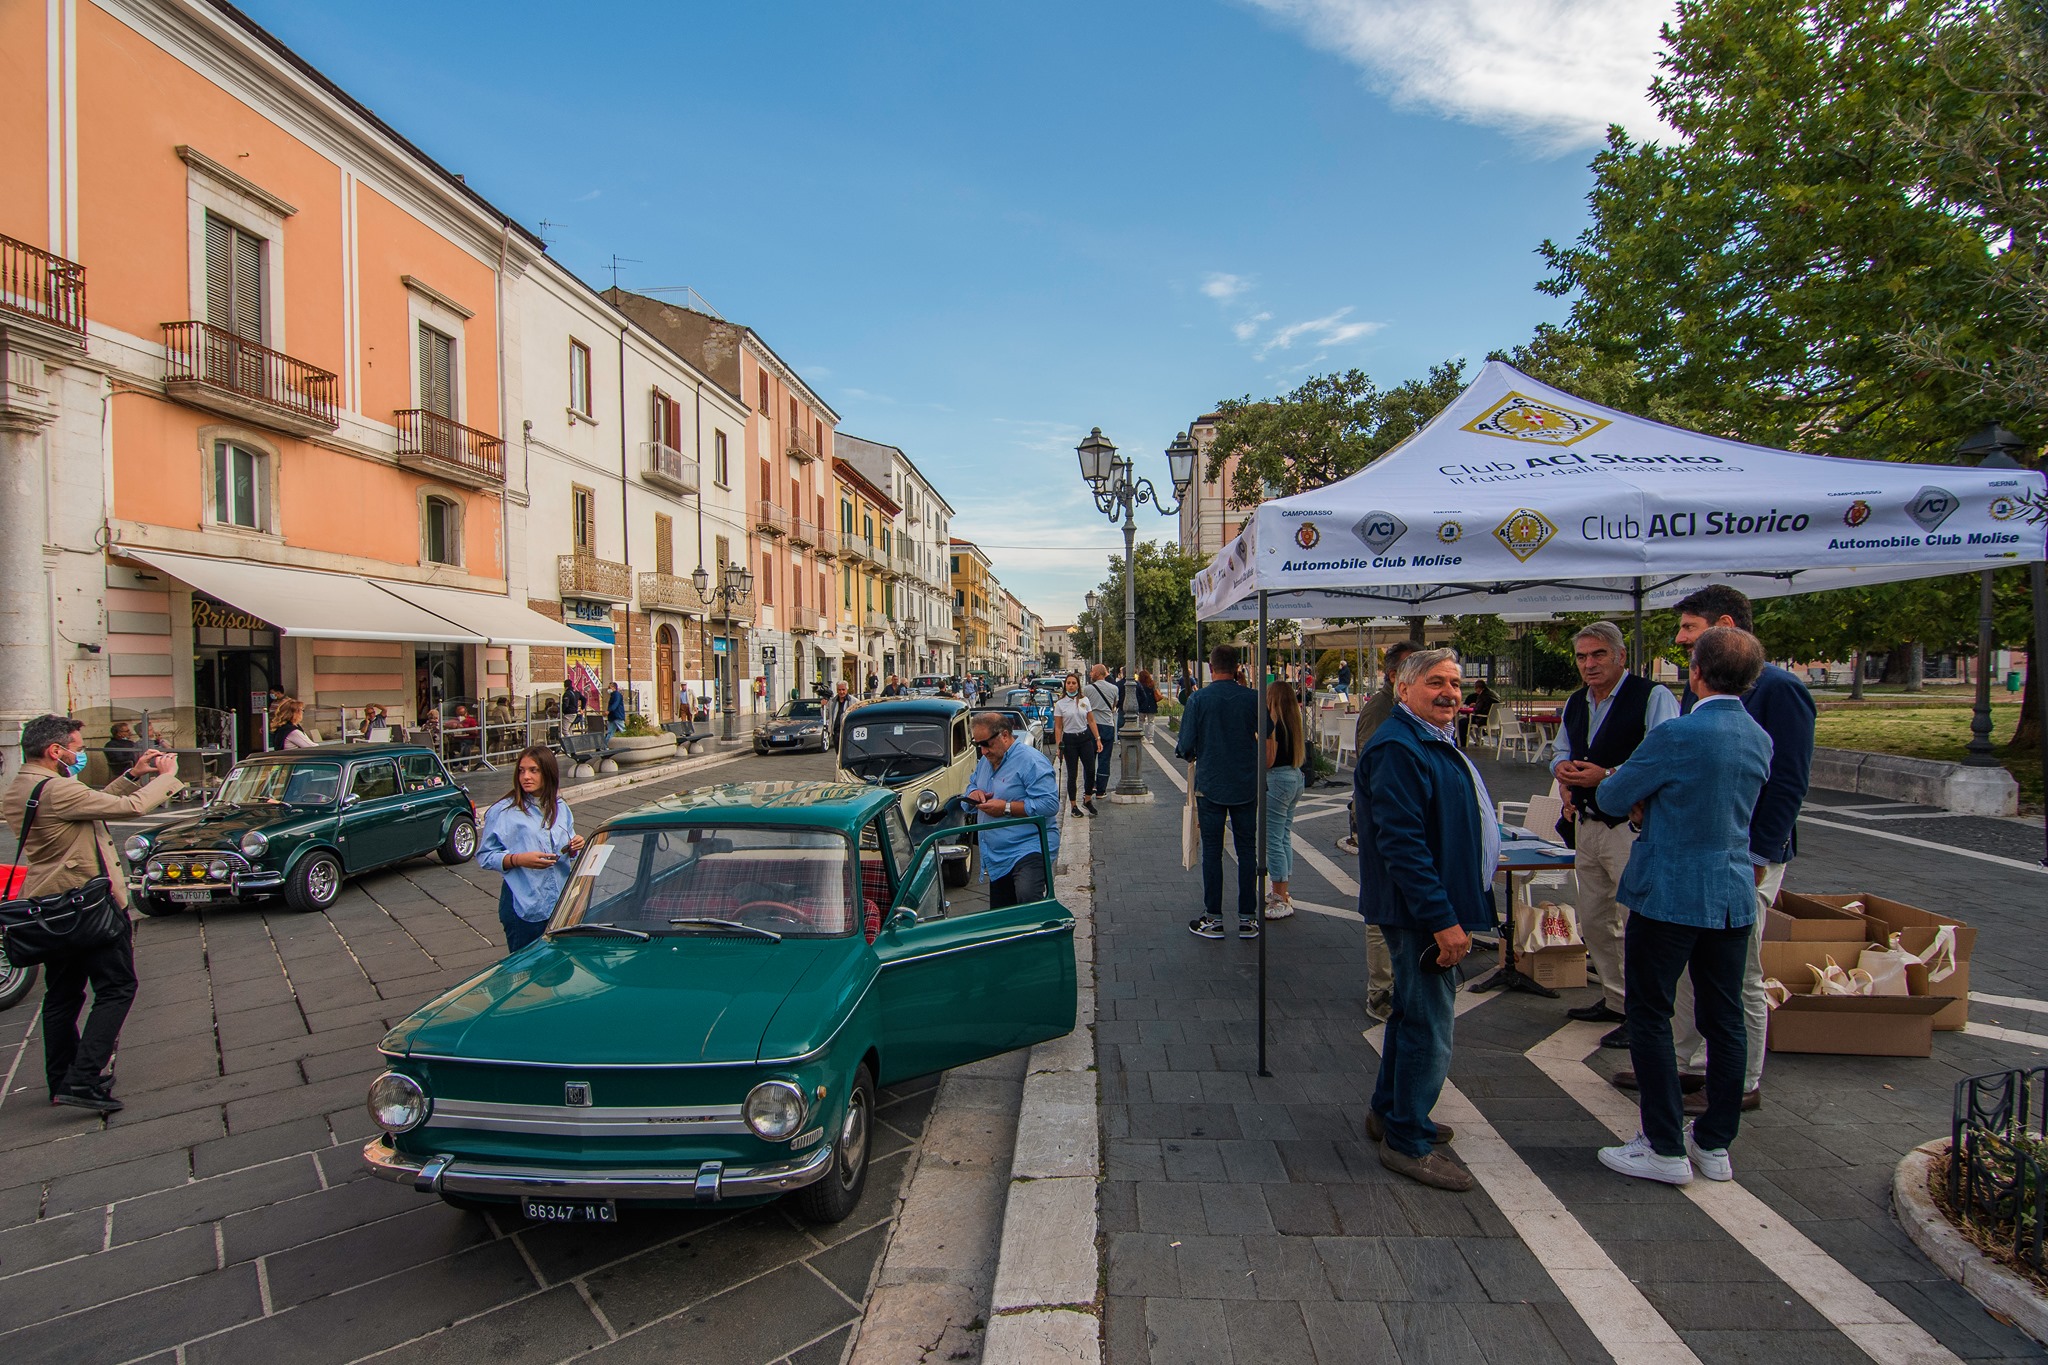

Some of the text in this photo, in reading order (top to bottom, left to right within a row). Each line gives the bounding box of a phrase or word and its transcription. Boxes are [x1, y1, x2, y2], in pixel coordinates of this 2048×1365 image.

[1438, 453, 1724, 476] Club ACI Storico
[1470, 471, 1545, 484] futuro
[1613, 463, 1667, 473] stile
[1671, 464, 1745, 473] antico
[1918, 498, 1949, 514] ACI
[1367, 522, 1396, 536] ACI
[1582, 509, 1810, 540] Club ACI Storico
[1828, 532, 2020, 550] Automobile Club Molise
[1281, 554, 1463, 572] Automobile Club Molise
[855, 729, 866, 738] 36
[528, 1203, 574, 1220] 86347
